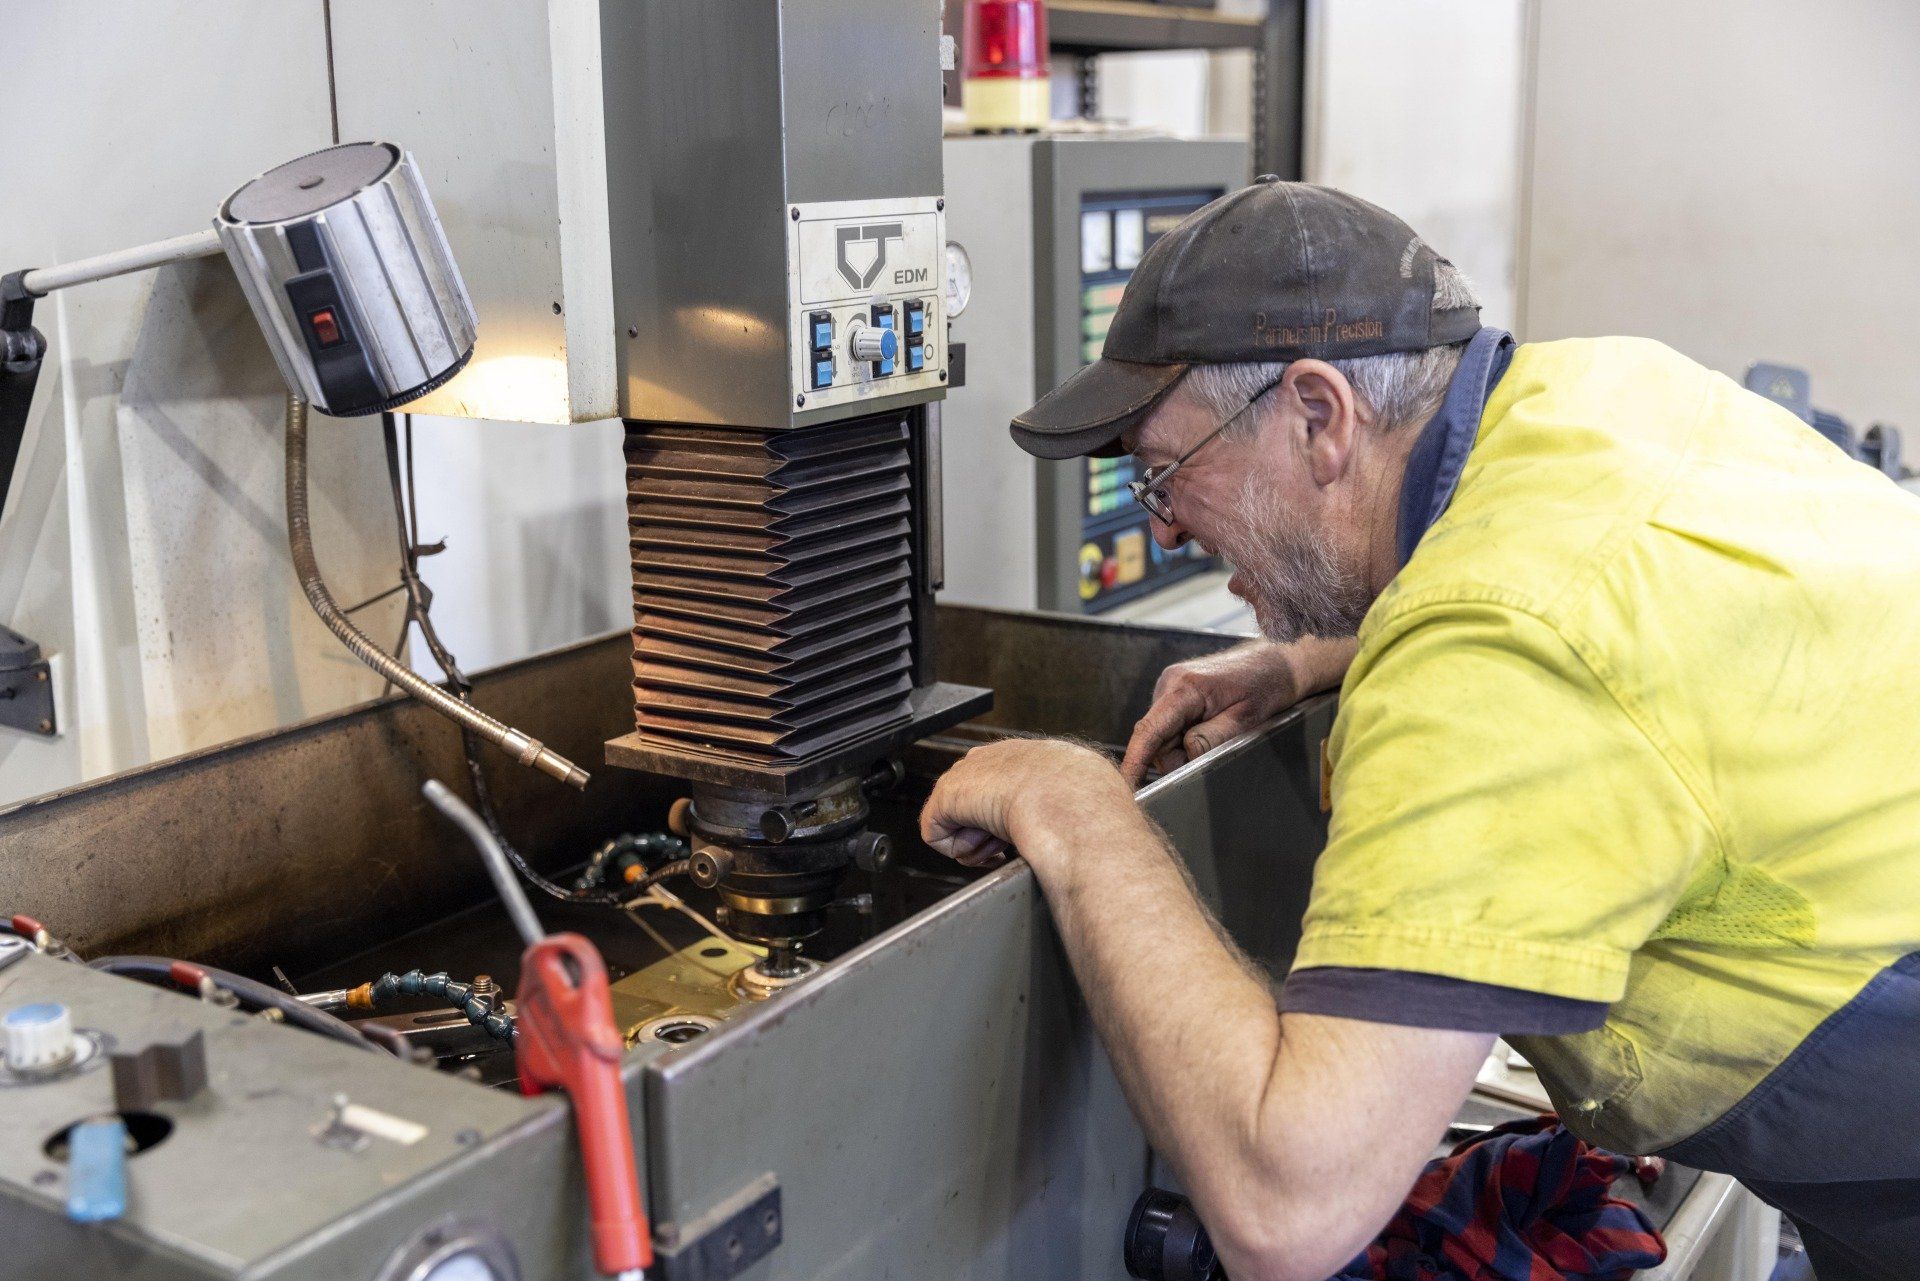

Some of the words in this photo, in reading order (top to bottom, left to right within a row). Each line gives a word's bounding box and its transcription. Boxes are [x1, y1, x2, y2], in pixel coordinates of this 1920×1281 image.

[894, 268, 928, 284] EDM
[1253, 312, 1307, 346] Partners
[1310, 323, 1321, 343] in
[1323, 307, 1383, 343] Precision
